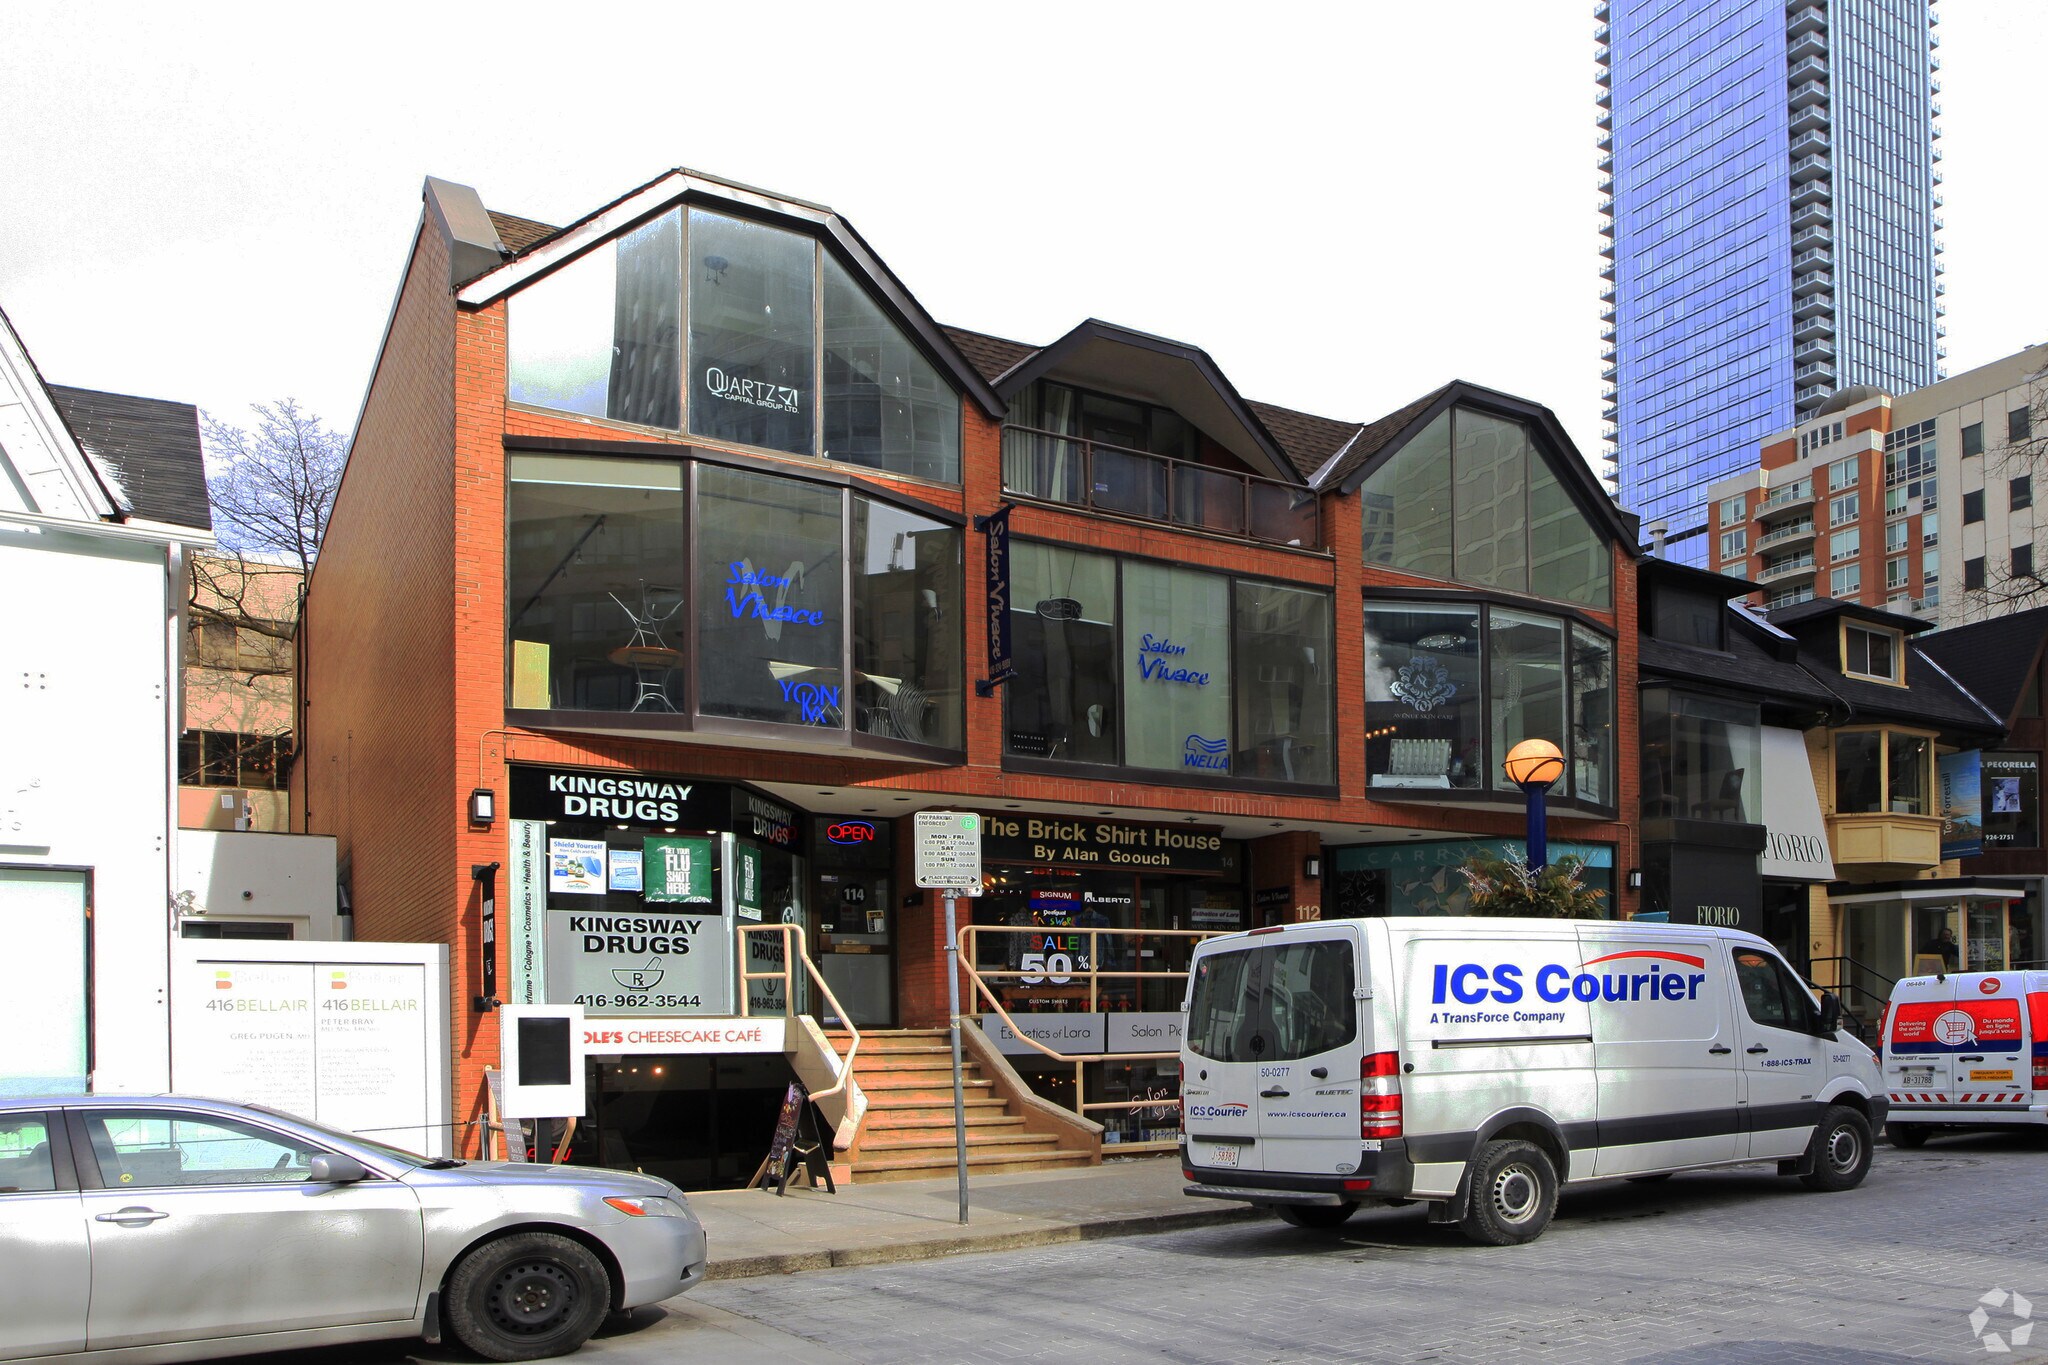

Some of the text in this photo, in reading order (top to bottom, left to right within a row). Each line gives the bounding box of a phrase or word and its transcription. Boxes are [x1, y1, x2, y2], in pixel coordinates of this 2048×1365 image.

[706, 367, 776, 402] QUARTZ
[724, 393, 800, 414] CAPITAL GROUP LTD.
[990, 520, 1004, 580] Salon
[726, 561, 791, 589] Salon
[724, 586, 825, 627] Vivace
[990, 580, 1006, 660] Vivace
[1139, 633, 1186, 656] Salon
[1137, 653, 1210, 687] Vivace
[1185, 753, 1229, 770] WELLA
[550, 775, 693, 801] KINGSWAY
[564, 795, 679, 822] DRUGS
[748, 797, 792, 826] KINGSWAY
[1943, 772, 1952, 835] Tom Forrestall
[522, 821, 533, 849] Beauty
[753, 815, 789, 845] DRUGS
[827, 824, 875, 840] OPEN
[980, 816, 1221, 850] The Brick Shirt House
[553, 841, 603, 850] Shield Yourself
[665, 854, 691, 871] FLU
[1035, 845, 1170, 866] By Alan Goouch
[523, 858, 532, 884] Health
[666, 871, 690, 882] SHOT
[666, 882, 691, 894] HERE
[843, 888, 865, 901] 114
[1040, 891, 1072, 899] SIGNUM
[1084, 892, 1131, 904] ALBERTO
[523, 891, 532, 931] Cosmetics
[1296, 905, 1321, 921] 112
[1697, 905, 1740, 926] FIORIO
[569, 916, 702, 935] KINGSWAY
[583, 935, 690, 954] DRUGS
[1031, 935, 1080, 951] SALE
[524, 939, 534, 971] Cologne
[1020, 953, 1073, 984] 50
[1432, 963, 1705, 1004] ICS Courier
[574, 994, 701, 1008] 416-962-3544
[750, 996, 787, 1010] 416-962-354
[351, 1018, 375, 1026] BRAY
[1430, 1011, 1565, 1024] A TransForce Company
[230, 1032, 257, 1040] GREG
[627, 1030, 721, 1043] CHEESECAKE
[725, 1027, 762, 1042] CAFÉ
[1000, 1025, 1091, 1040] Eshetics of Lara
[1131, 1024, 1163, 1038] Salon
[1760, 1057, 1812, 1068] 1-888-ICS-TRAX
[1832, 1054, 1851, 1063] 50-0277
[1260, 1067, 1290, 1078] 50-0277
[1190, 1106, 1248, 1117] ICS Courier
